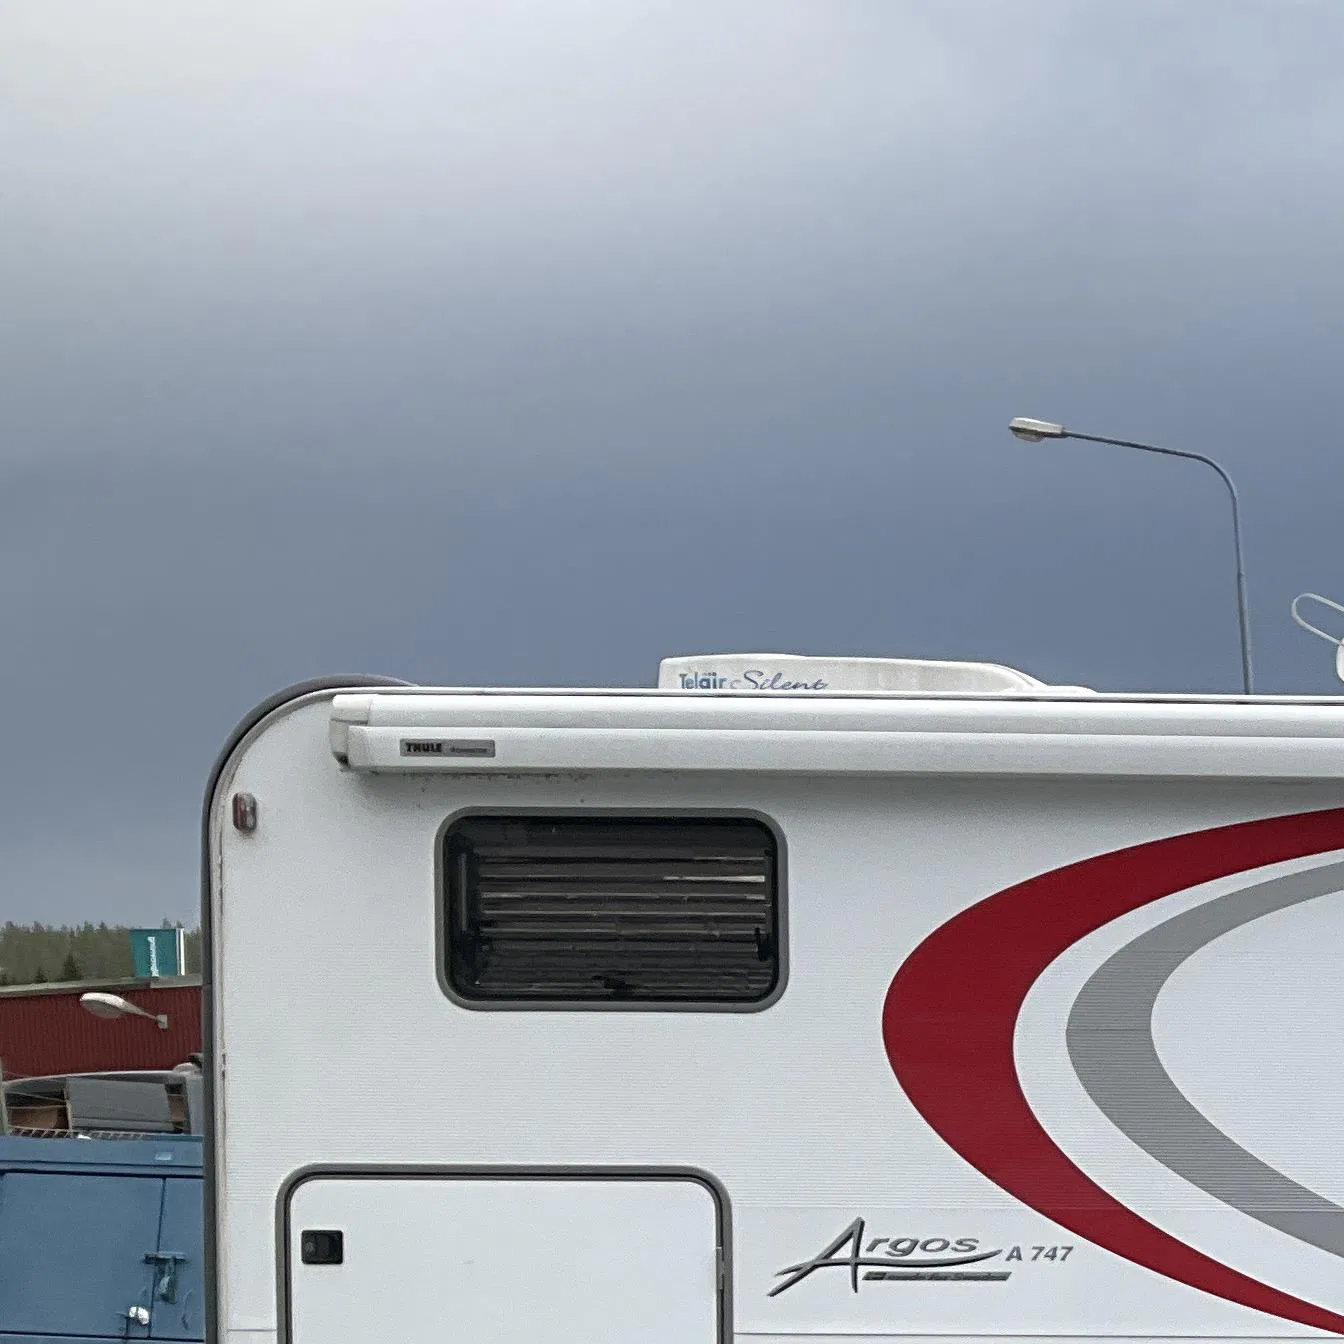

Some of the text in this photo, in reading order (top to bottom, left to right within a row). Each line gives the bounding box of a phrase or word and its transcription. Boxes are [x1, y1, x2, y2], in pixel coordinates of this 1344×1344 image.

[678, 669, 829, 690] Telair Silent
[404, 742, 443, 753] THULE
[766, 1216, 988, 1298] Argos
[1005, 1246, 1023, 1262] A
[1031, 1245, 1074, 1262] 747
